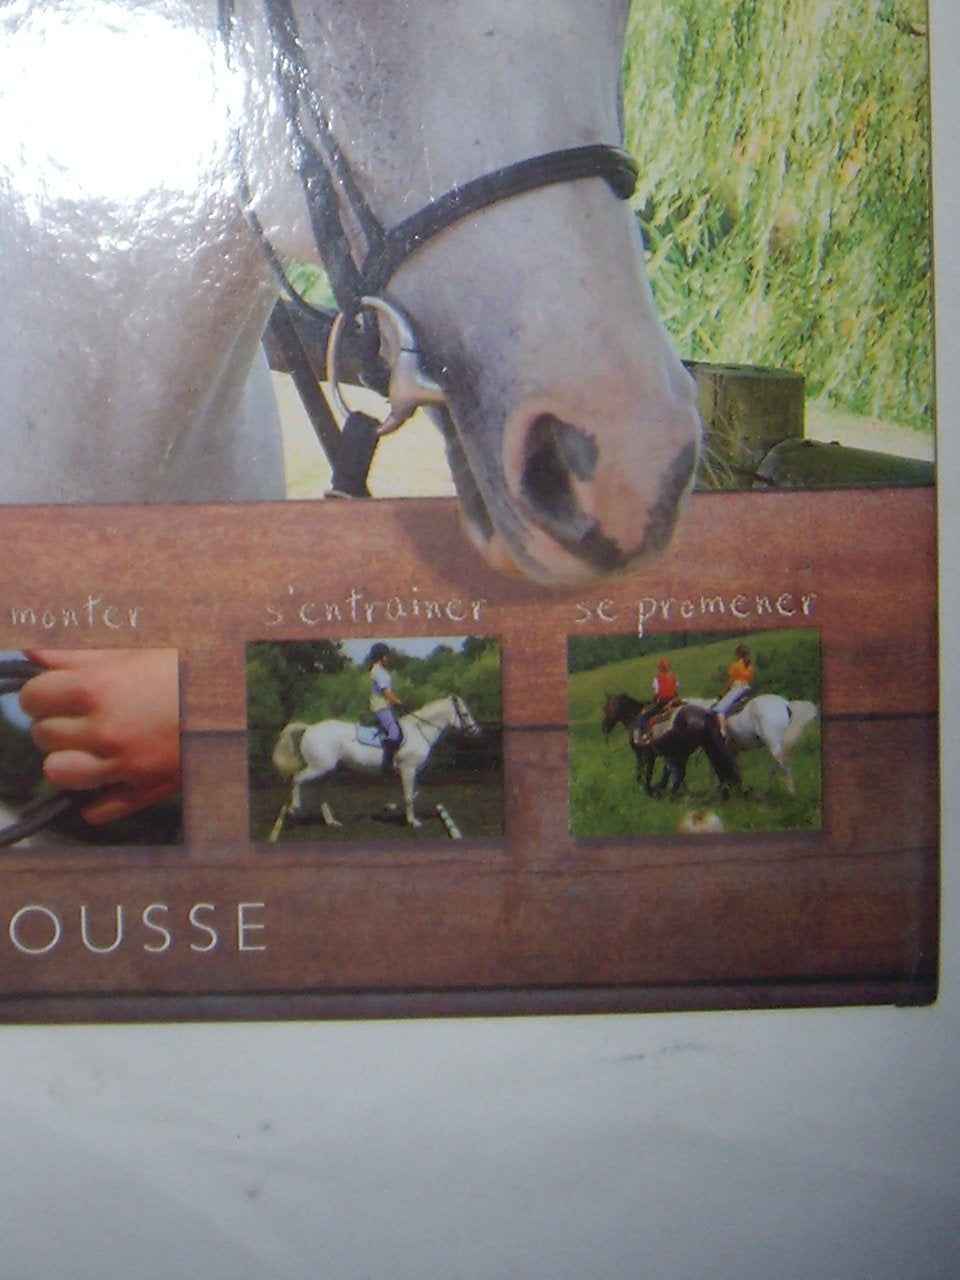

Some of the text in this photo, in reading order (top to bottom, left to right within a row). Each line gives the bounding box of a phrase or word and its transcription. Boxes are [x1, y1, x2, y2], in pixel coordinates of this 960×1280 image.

[11, 595, 145, 628] monter
[575, 590, 819, 638] se promener
